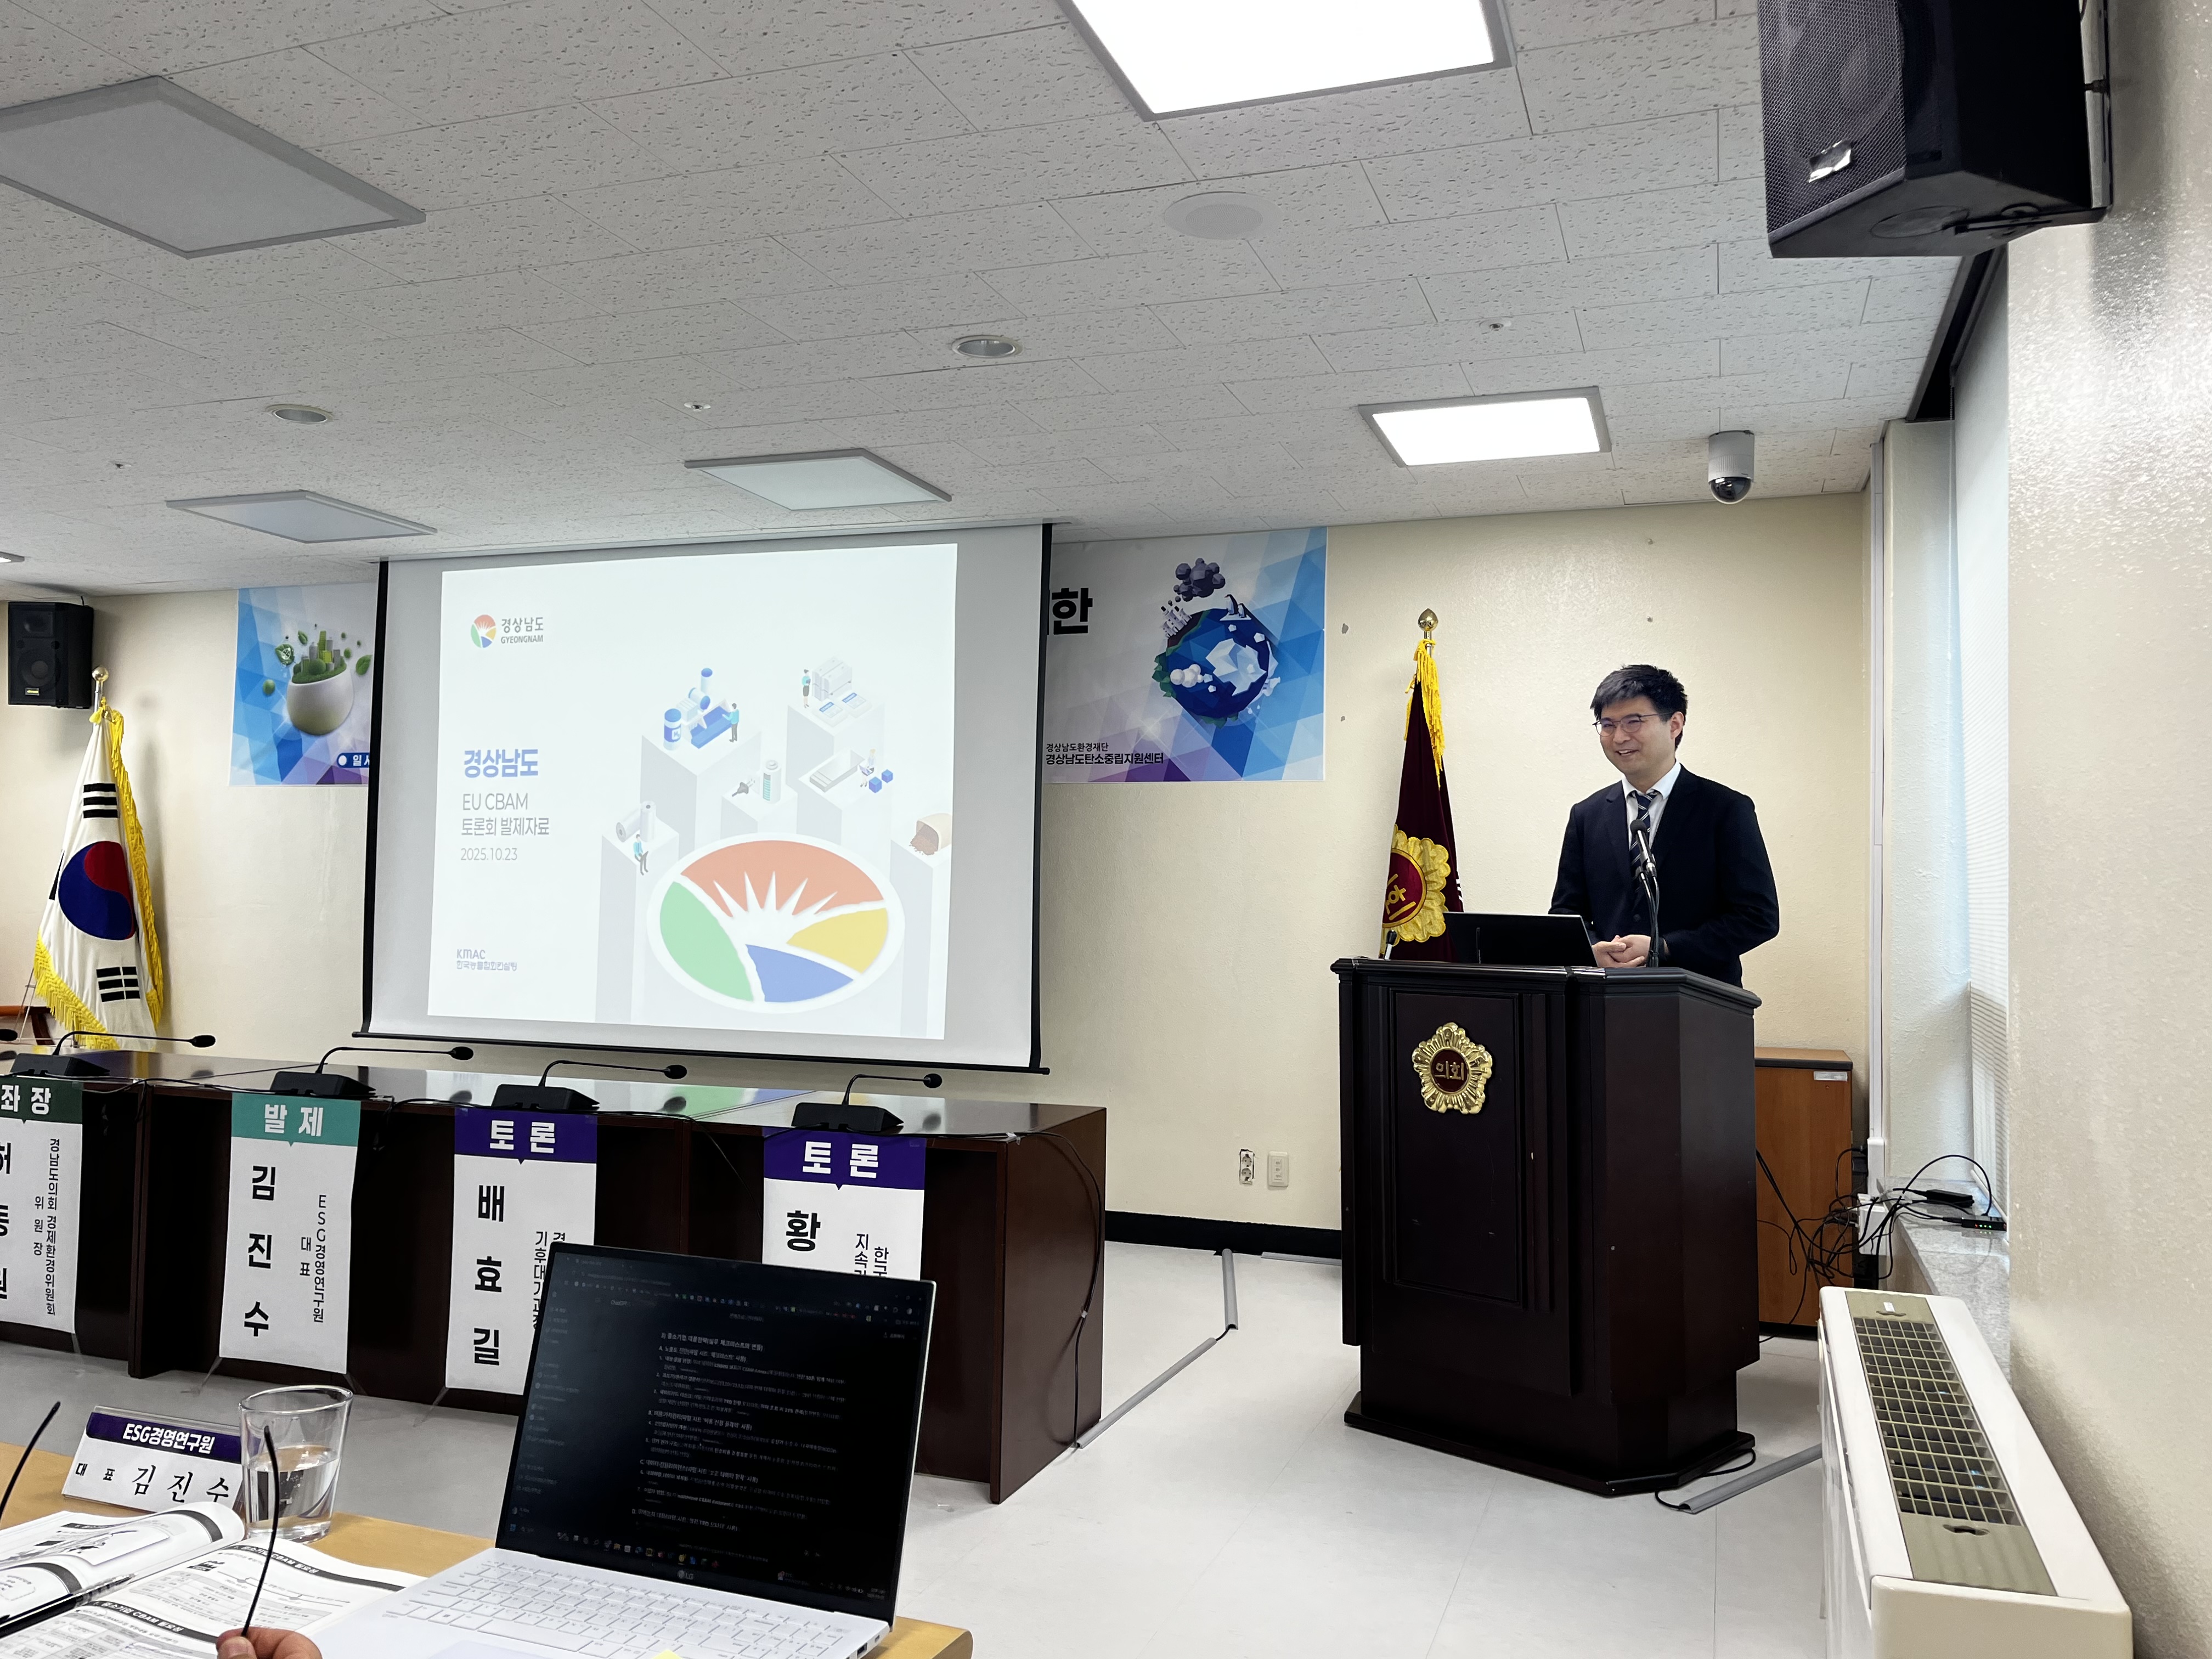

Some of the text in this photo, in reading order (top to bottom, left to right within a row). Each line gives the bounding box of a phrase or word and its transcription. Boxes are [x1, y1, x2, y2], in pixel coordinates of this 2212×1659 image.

[1047, 588, 1093, 635] 한
[501, 617, 544, 633] 경상남도
[500, 635, 544, 644] GYEONGNAM
[1046, 742, 1109, 753] 경상남도환경재단
[464, 749, 538, 778] 경상남도
[1046, 753, 1164, 765] 경상남도탄소중립지원센터
[462, 793, 528, 810] EU CBAM
[461, 817, 549, 836] 토론회 발제자료
[460, 848, 518, 861] 2025.10.23
[456, 949, 486, 960] KMAC
[1434, 1060, 1464, 1081] 의회
[44, 1138, 60, 1316] 경남도의회 경제환경위원회
[786, 1210, 821, 1251] 황
[122, 1423, 215, 1454] ESG경영연구원
[132, 1611, 160, 1624] CBAM
